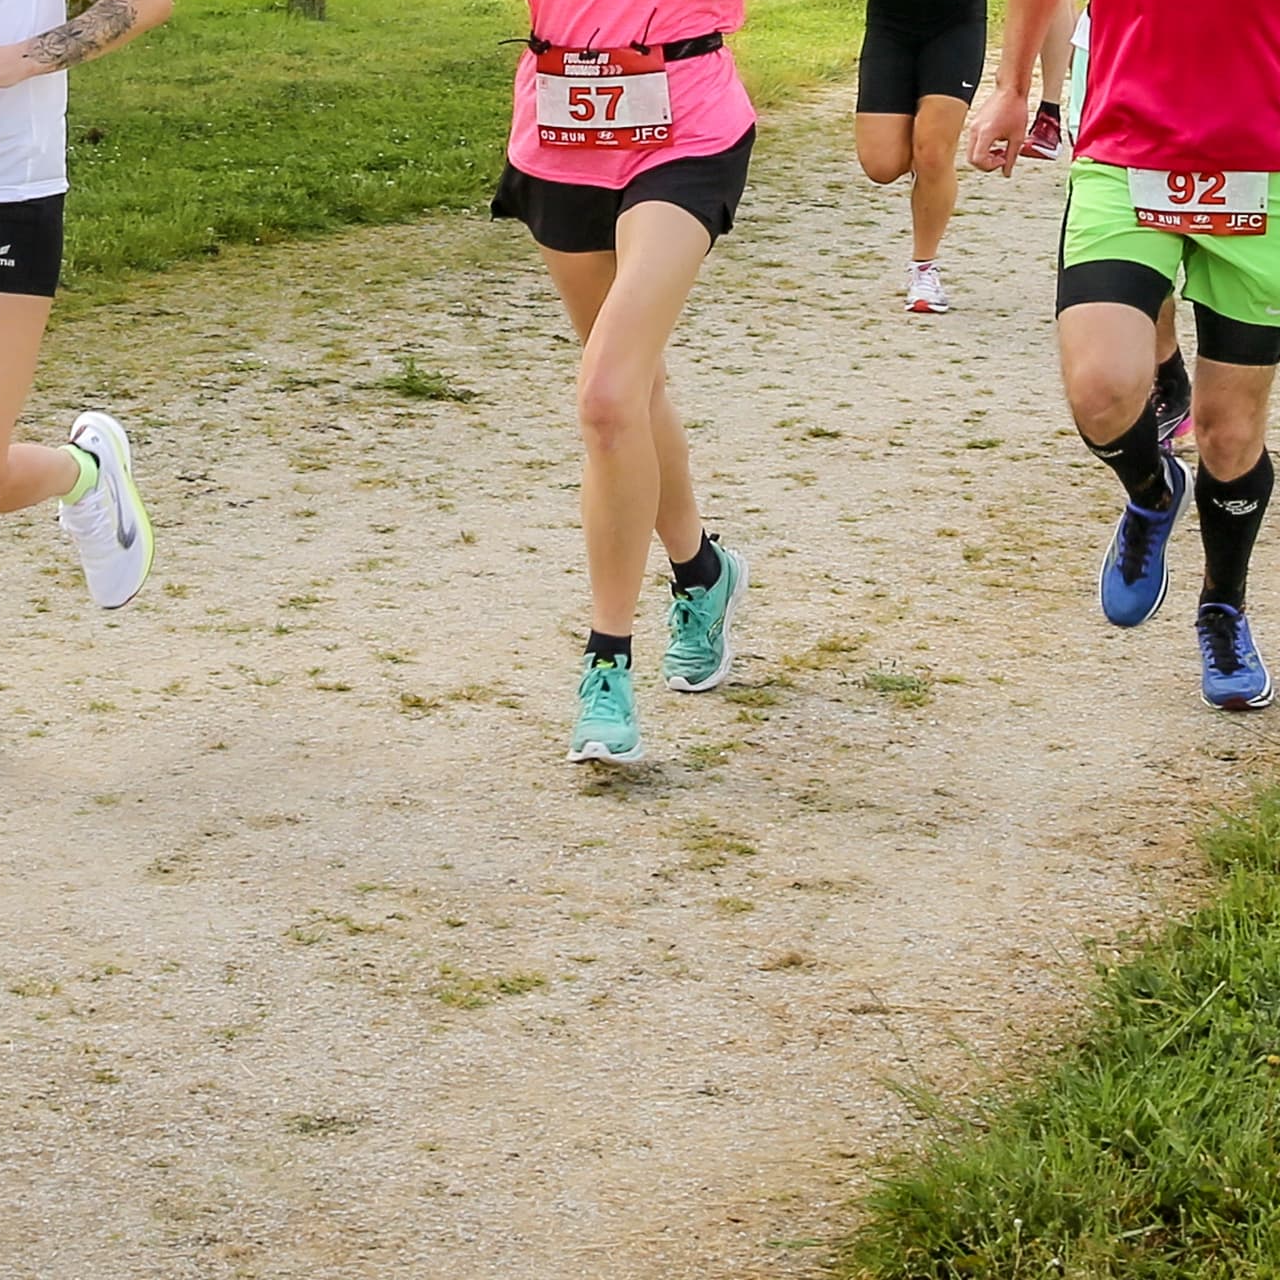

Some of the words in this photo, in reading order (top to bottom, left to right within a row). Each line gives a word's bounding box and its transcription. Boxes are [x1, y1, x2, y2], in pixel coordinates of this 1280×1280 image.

[569, 85, 624, 122] 57
[561, 131, 586, 142] RUN
[631, 126, 669, 142] JFC
[1167, 171, 1226, 205] 92
[1158, 215, 1181, 226] RUN
[1226, 214, 1263, 228] JFC
